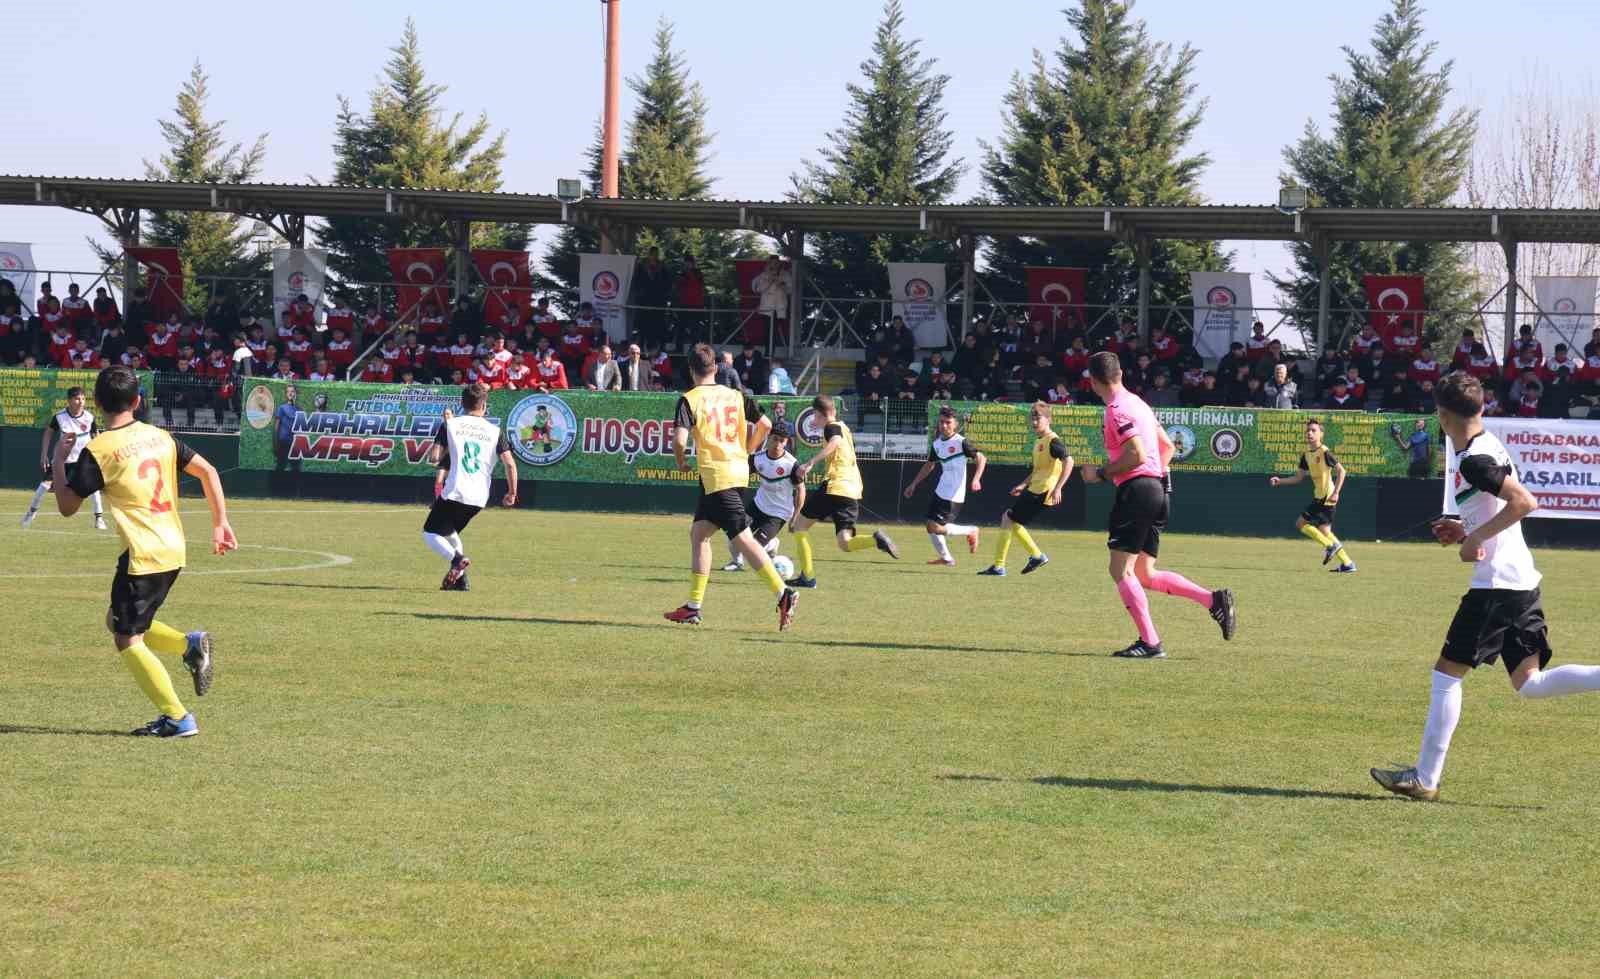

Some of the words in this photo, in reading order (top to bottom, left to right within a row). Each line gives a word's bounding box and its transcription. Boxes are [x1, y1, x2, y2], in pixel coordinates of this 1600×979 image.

[344, 400, 401, 413] FUTBOL
[291, 411, 500, 437] MAHALLE
[706, 406, 737, 442] 15
[288, 434, 395, 469] MAÇ
[462, 441, 481, 474] 8
[1520, 449, 1555, 463] TÜM
[137, 458, 172, 513] 2
[1517, 470, 1600, 488] AŞARIL
[1536, 496, 1558, 506] AN
